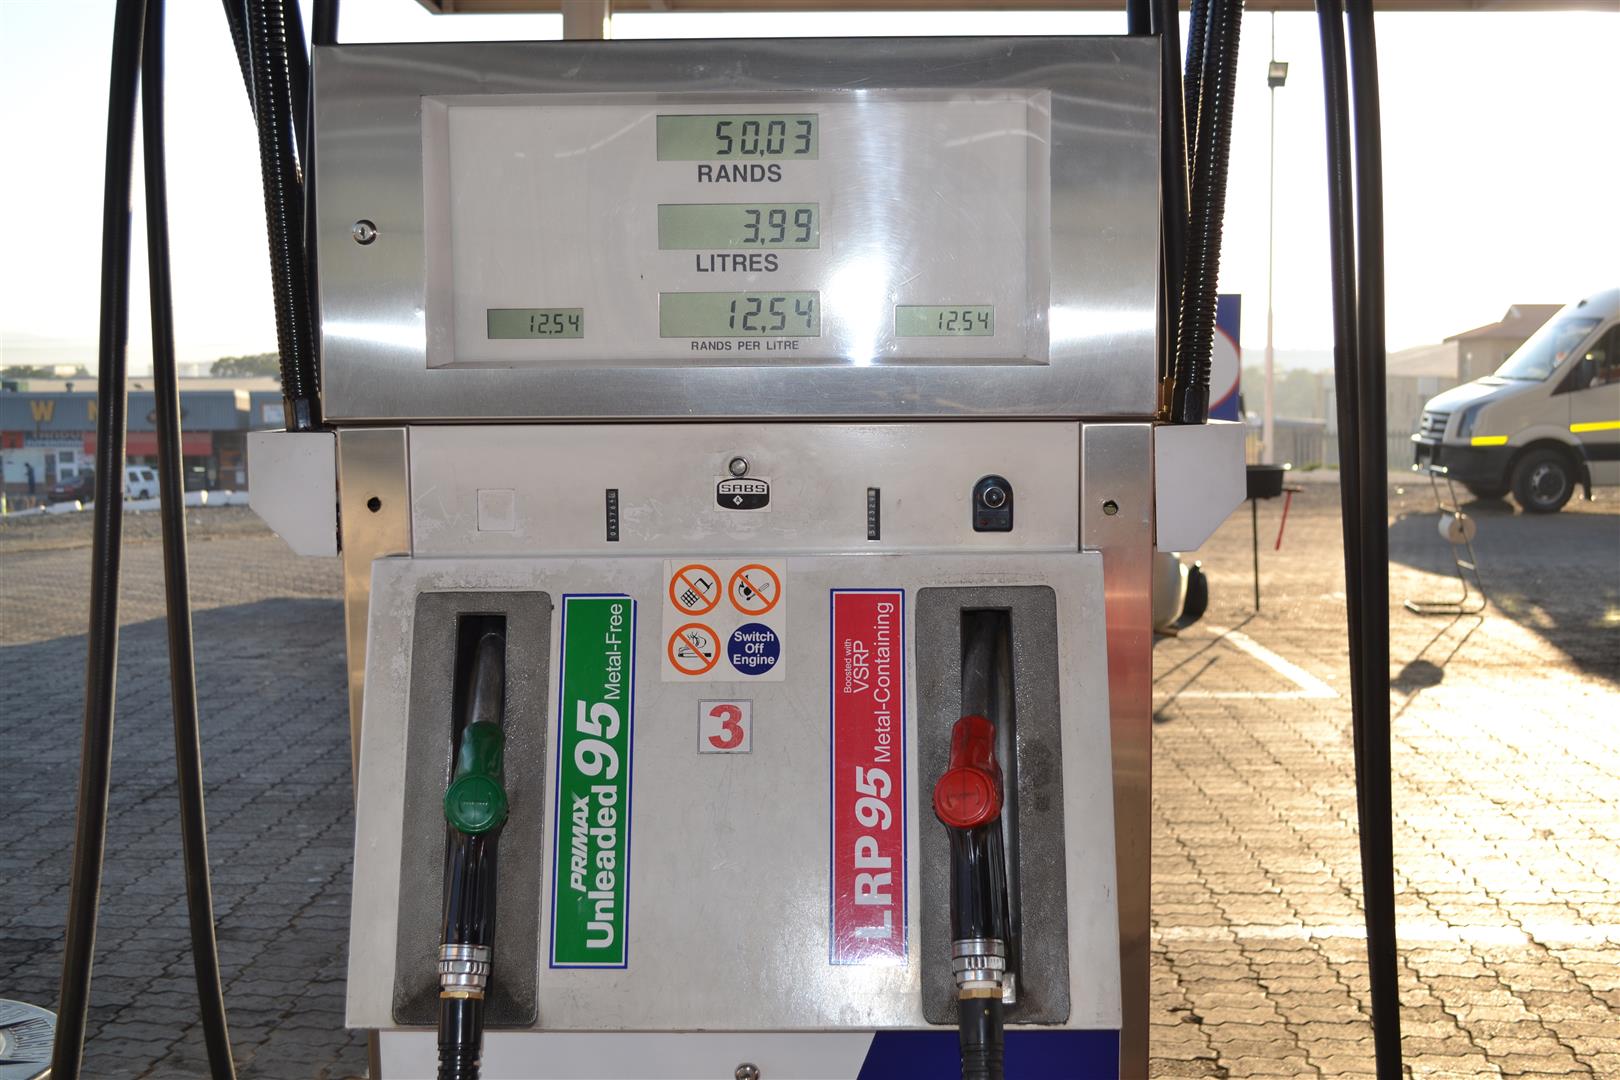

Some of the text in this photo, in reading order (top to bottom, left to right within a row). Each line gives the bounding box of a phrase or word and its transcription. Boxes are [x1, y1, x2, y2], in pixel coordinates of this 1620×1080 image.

[697, 163, 782, 183] RANDS
[696, 253, 779, 272] LITRES
[691, 340, 800, 351] RANDS PER LITRE
[721, 484, 766, 493] SABS
[734, 631, 775, 643] Switch
[745, 643, 765, 654] Off
[733, 654, 775, 668] Engine
[843, 638, 852, 694] Boosted with
[853, 640, 869, 693] VSRP
[708, 704, 744, 749] 3
[574, 603, 623, 948] Unleaded 95 Metal-Free
[854, 602, 894, 939] LRP 95 Metal-Containing
[570, 791, 590, 893] PRIMAX
